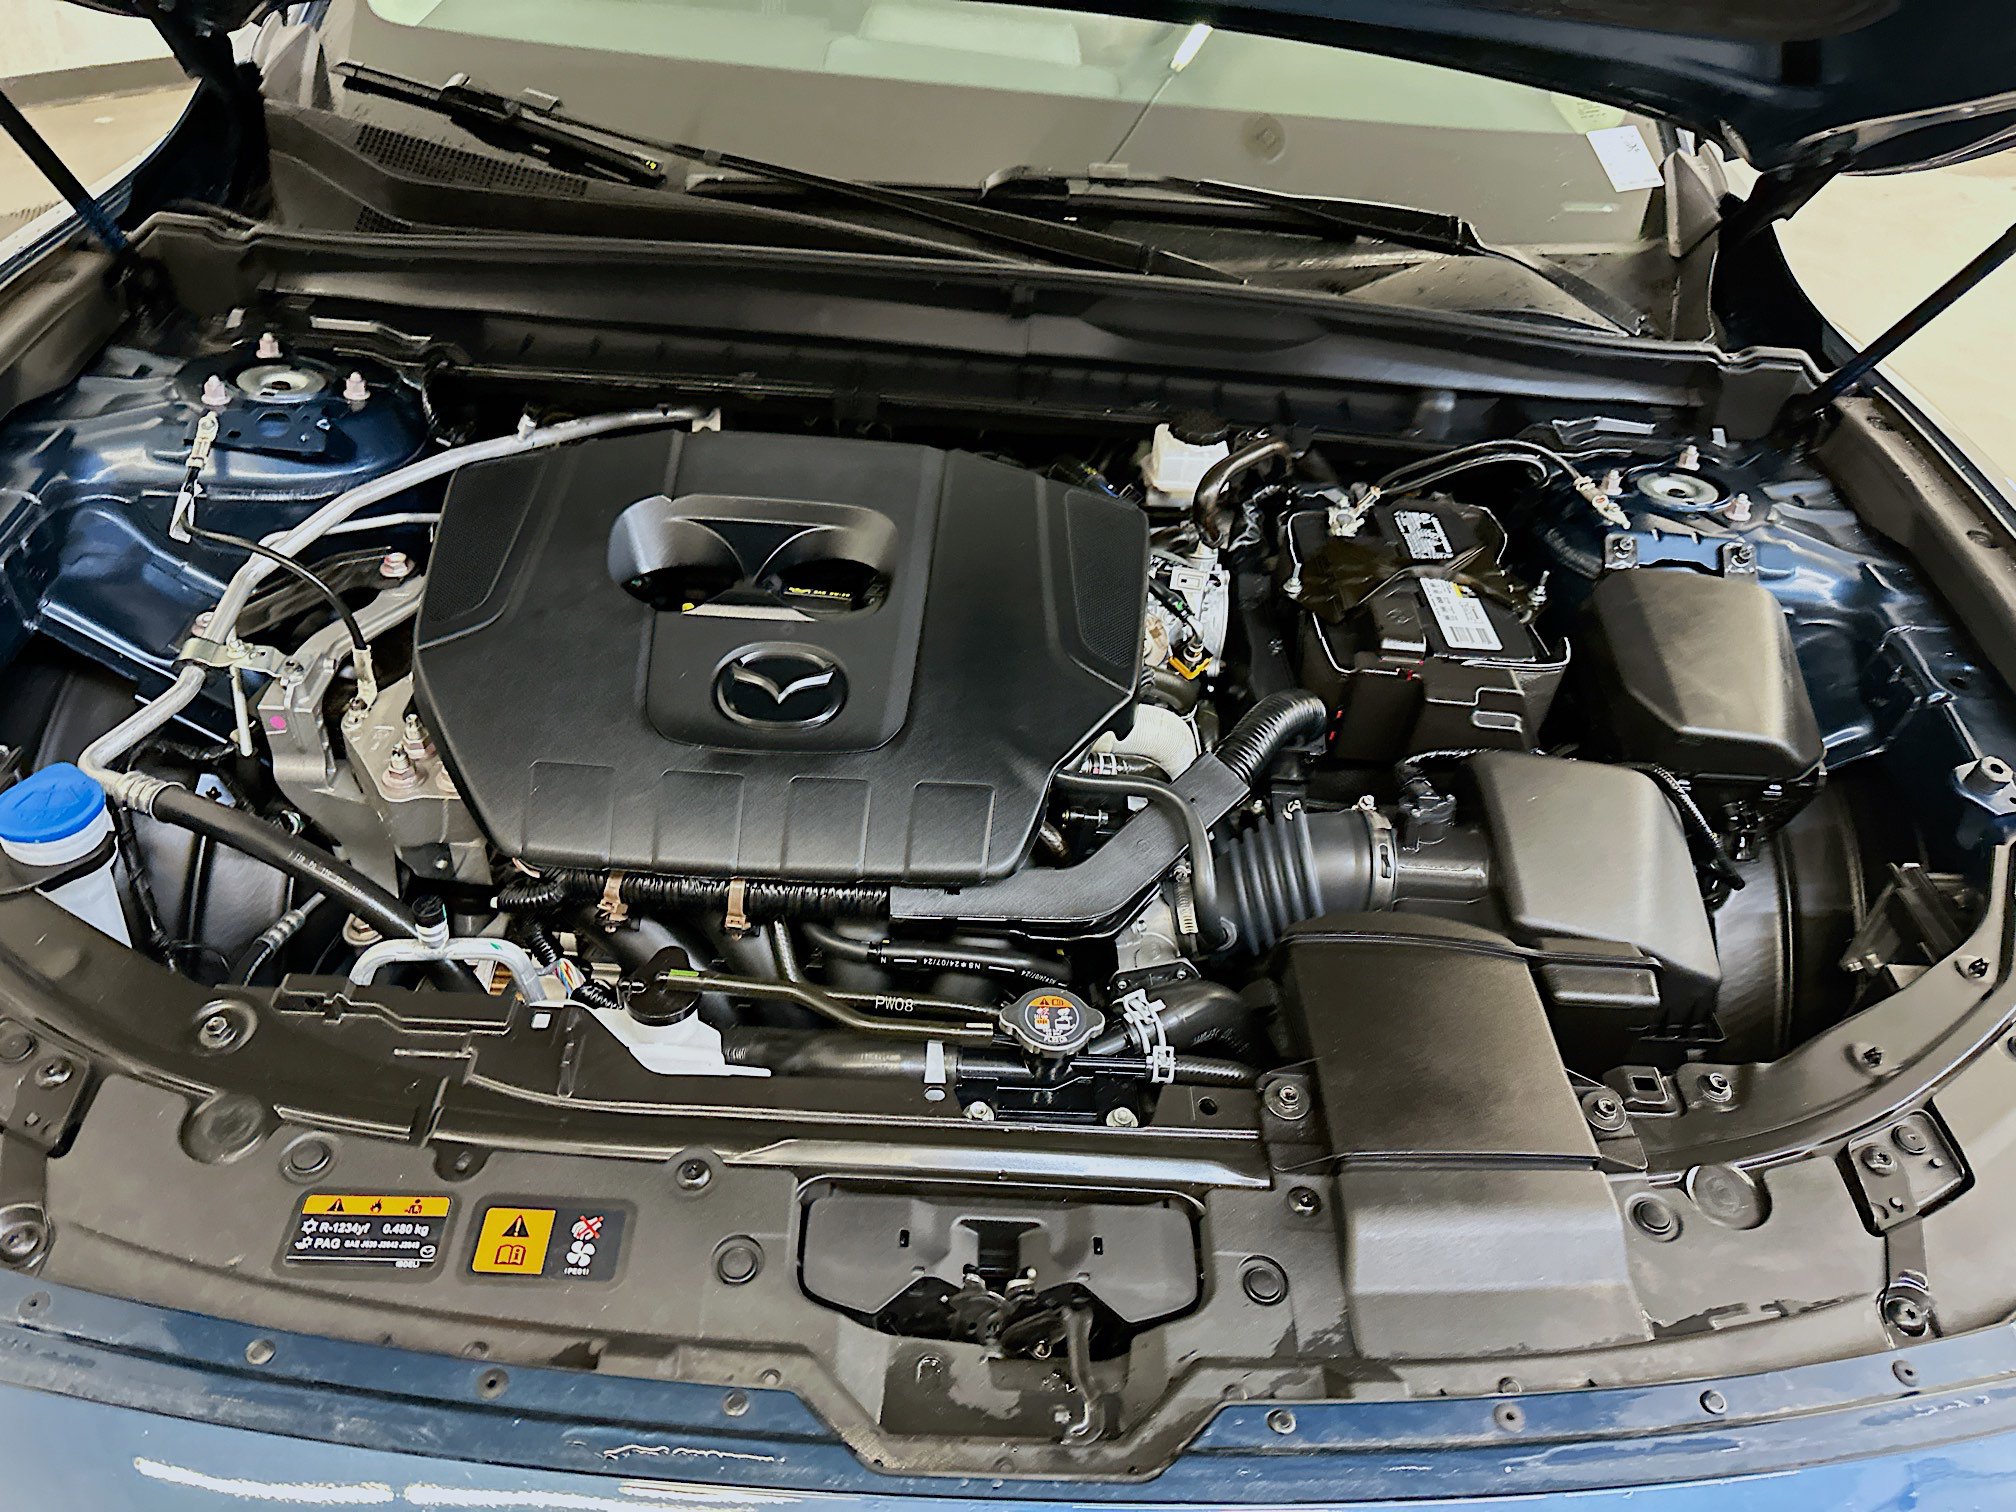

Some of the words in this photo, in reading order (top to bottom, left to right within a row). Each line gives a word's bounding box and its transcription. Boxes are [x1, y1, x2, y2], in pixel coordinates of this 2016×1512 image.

[875, 995, 914, 1012] PW08
[318, 1222, 371, 1236] R-1234yf
[414, 1223, 430, 1237] kg
[314, 1238, 341, 1249] PAG
